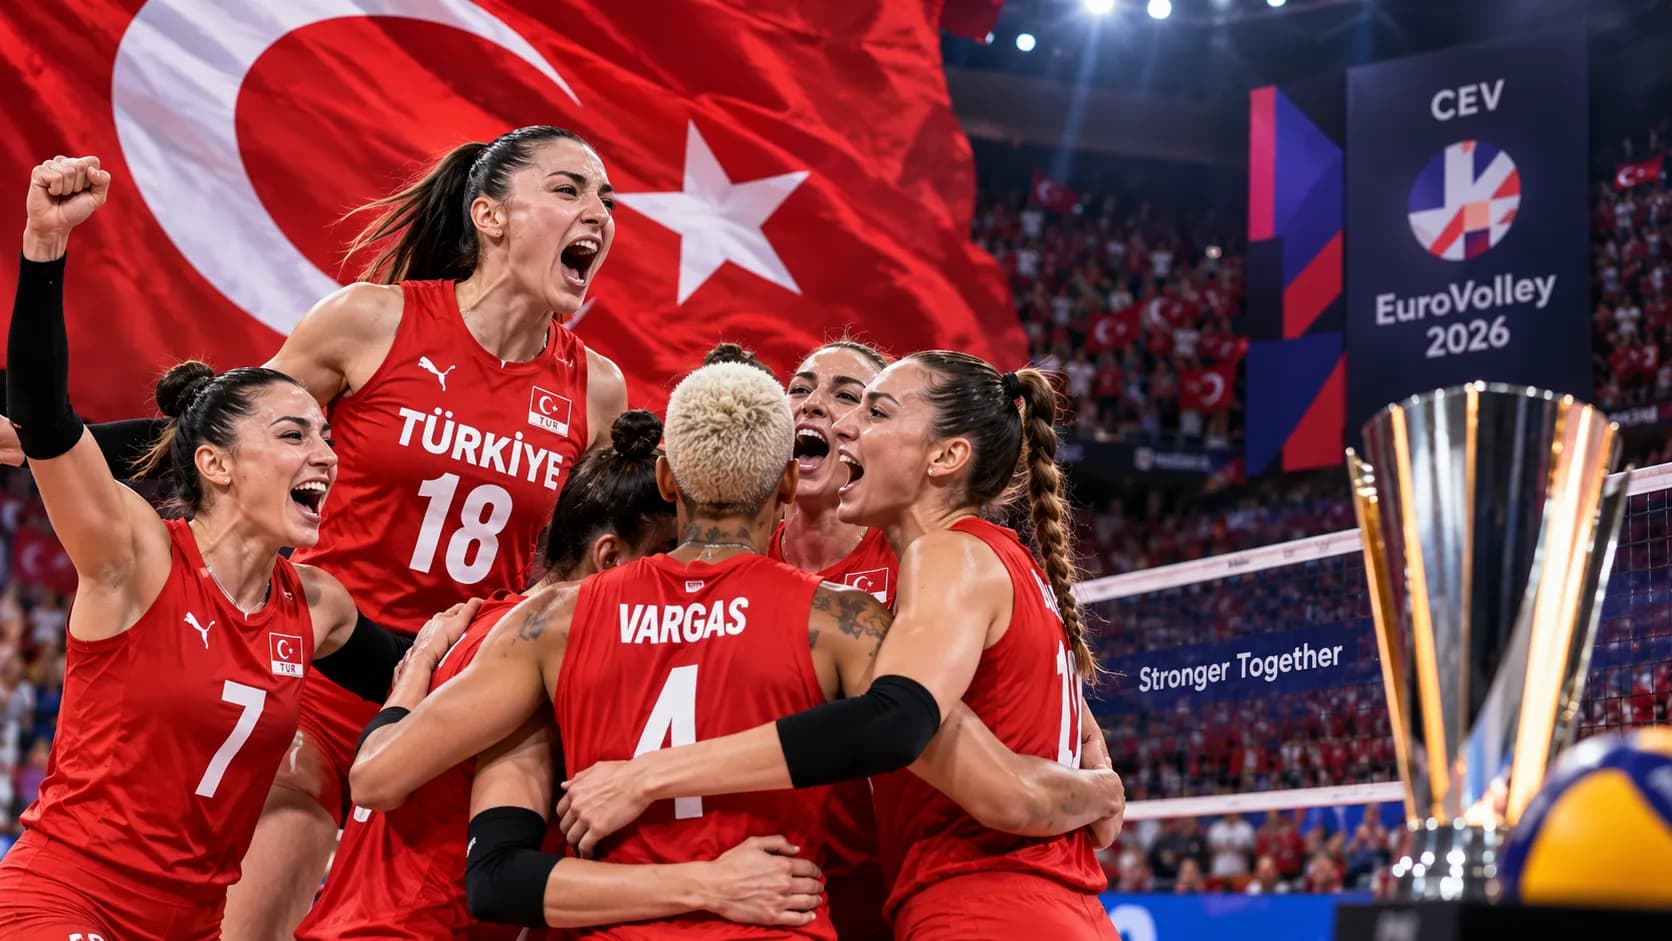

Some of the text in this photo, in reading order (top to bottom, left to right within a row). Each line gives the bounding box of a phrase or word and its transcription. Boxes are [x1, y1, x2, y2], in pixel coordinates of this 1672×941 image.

[1431, 79, 1505, 120] CEV
[1376, 273, 1557, 325] EuroVolley
[1426, 315, 1510, 358] 2026
[539, 416, 559, 430] TUR
[399, 406, 563, 490] TÜRKİYE
[409, 472, 513, 585] 18
[619, 597, 749, 644] VARGAS
[279, 662, 297, 673] TUR
[1139, 643, 1343, 692] Stronger Together
[195, 680, 267, 798] 7
[633, 664, 703, 819] 4
